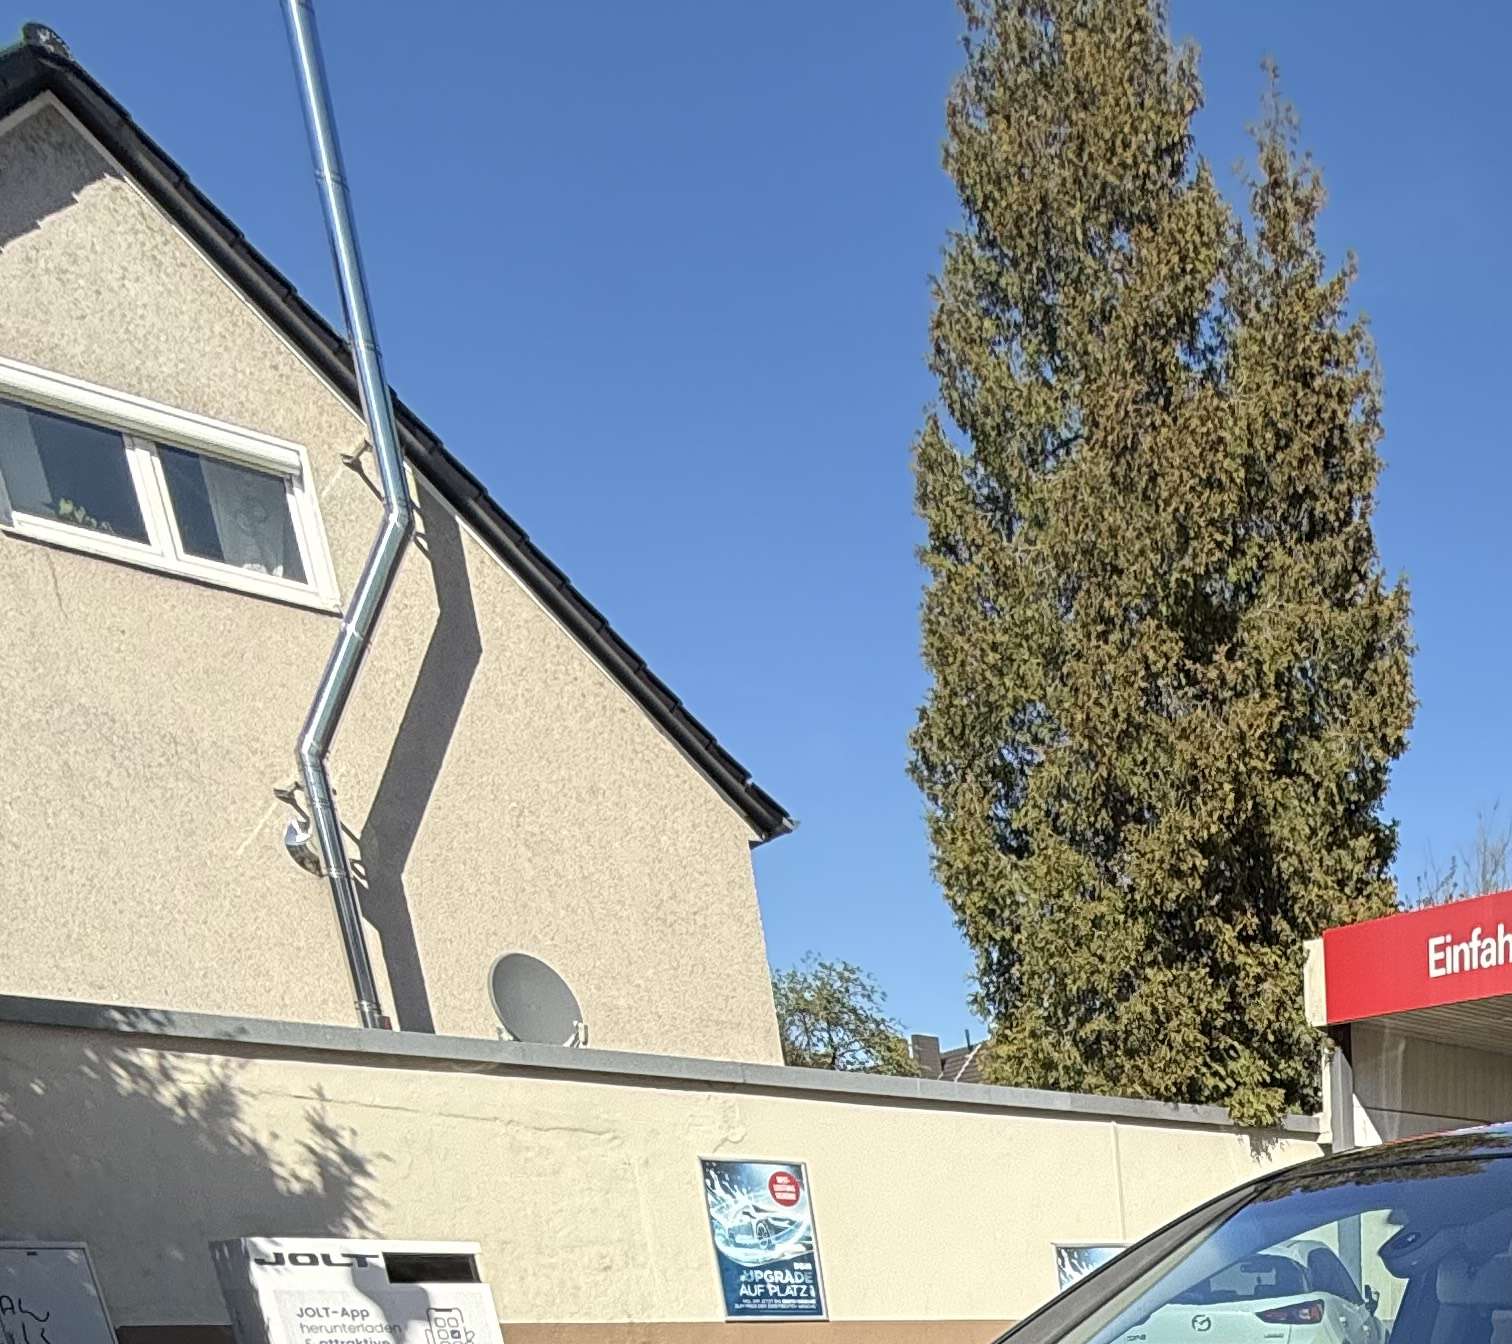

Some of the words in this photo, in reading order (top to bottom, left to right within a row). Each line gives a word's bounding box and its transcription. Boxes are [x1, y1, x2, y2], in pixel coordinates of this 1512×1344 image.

[254, 1252, 379, 1268] JOLT
[740, 1269, 814, 1284] UPGRADE
[739, 1284, 765, 1297] AUF
[767, 1283, 808, 1297] PLATZ
[296, 1306, 370, 1320] JOLT-App
[299, 1322, 402, 1335] herunterladen
